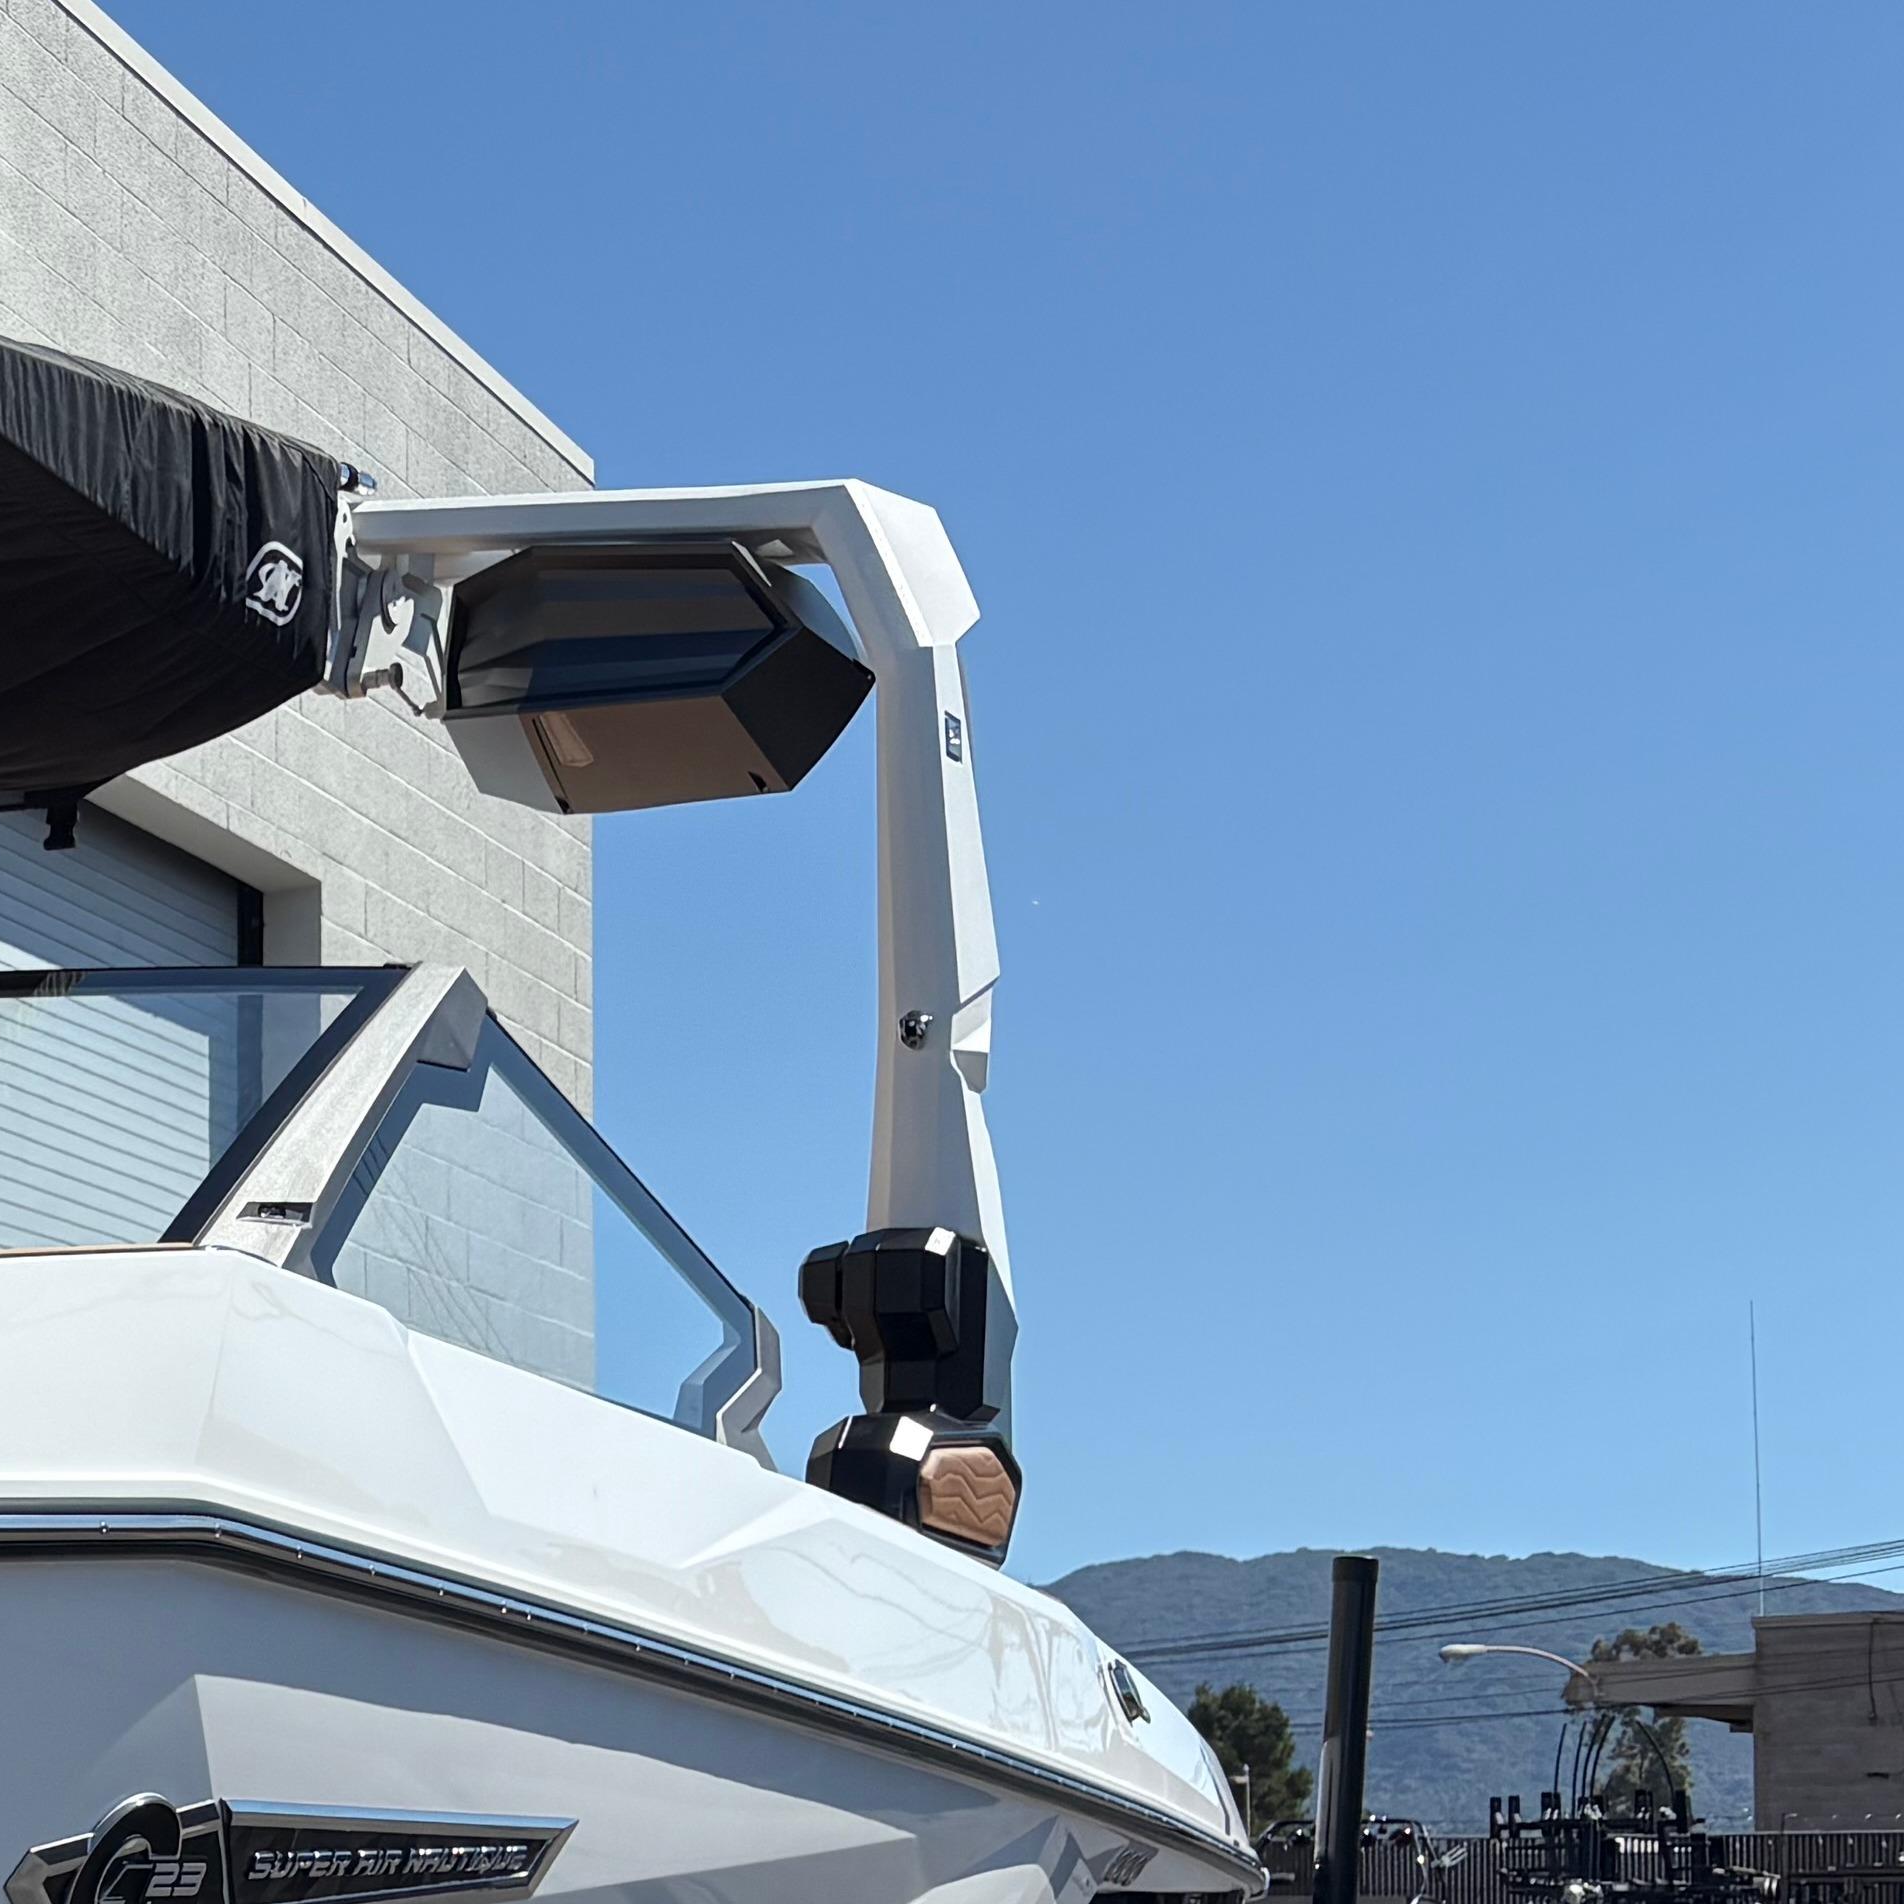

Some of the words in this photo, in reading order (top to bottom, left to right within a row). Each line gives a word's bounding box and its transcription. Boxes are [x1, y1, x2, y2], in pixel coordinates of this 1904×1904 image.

[248, 1849, 352, 1880] SUPER
[353, 1848, 403, 1876] AIR
[402, 1845, 528, 1875] NAUTIQUE
